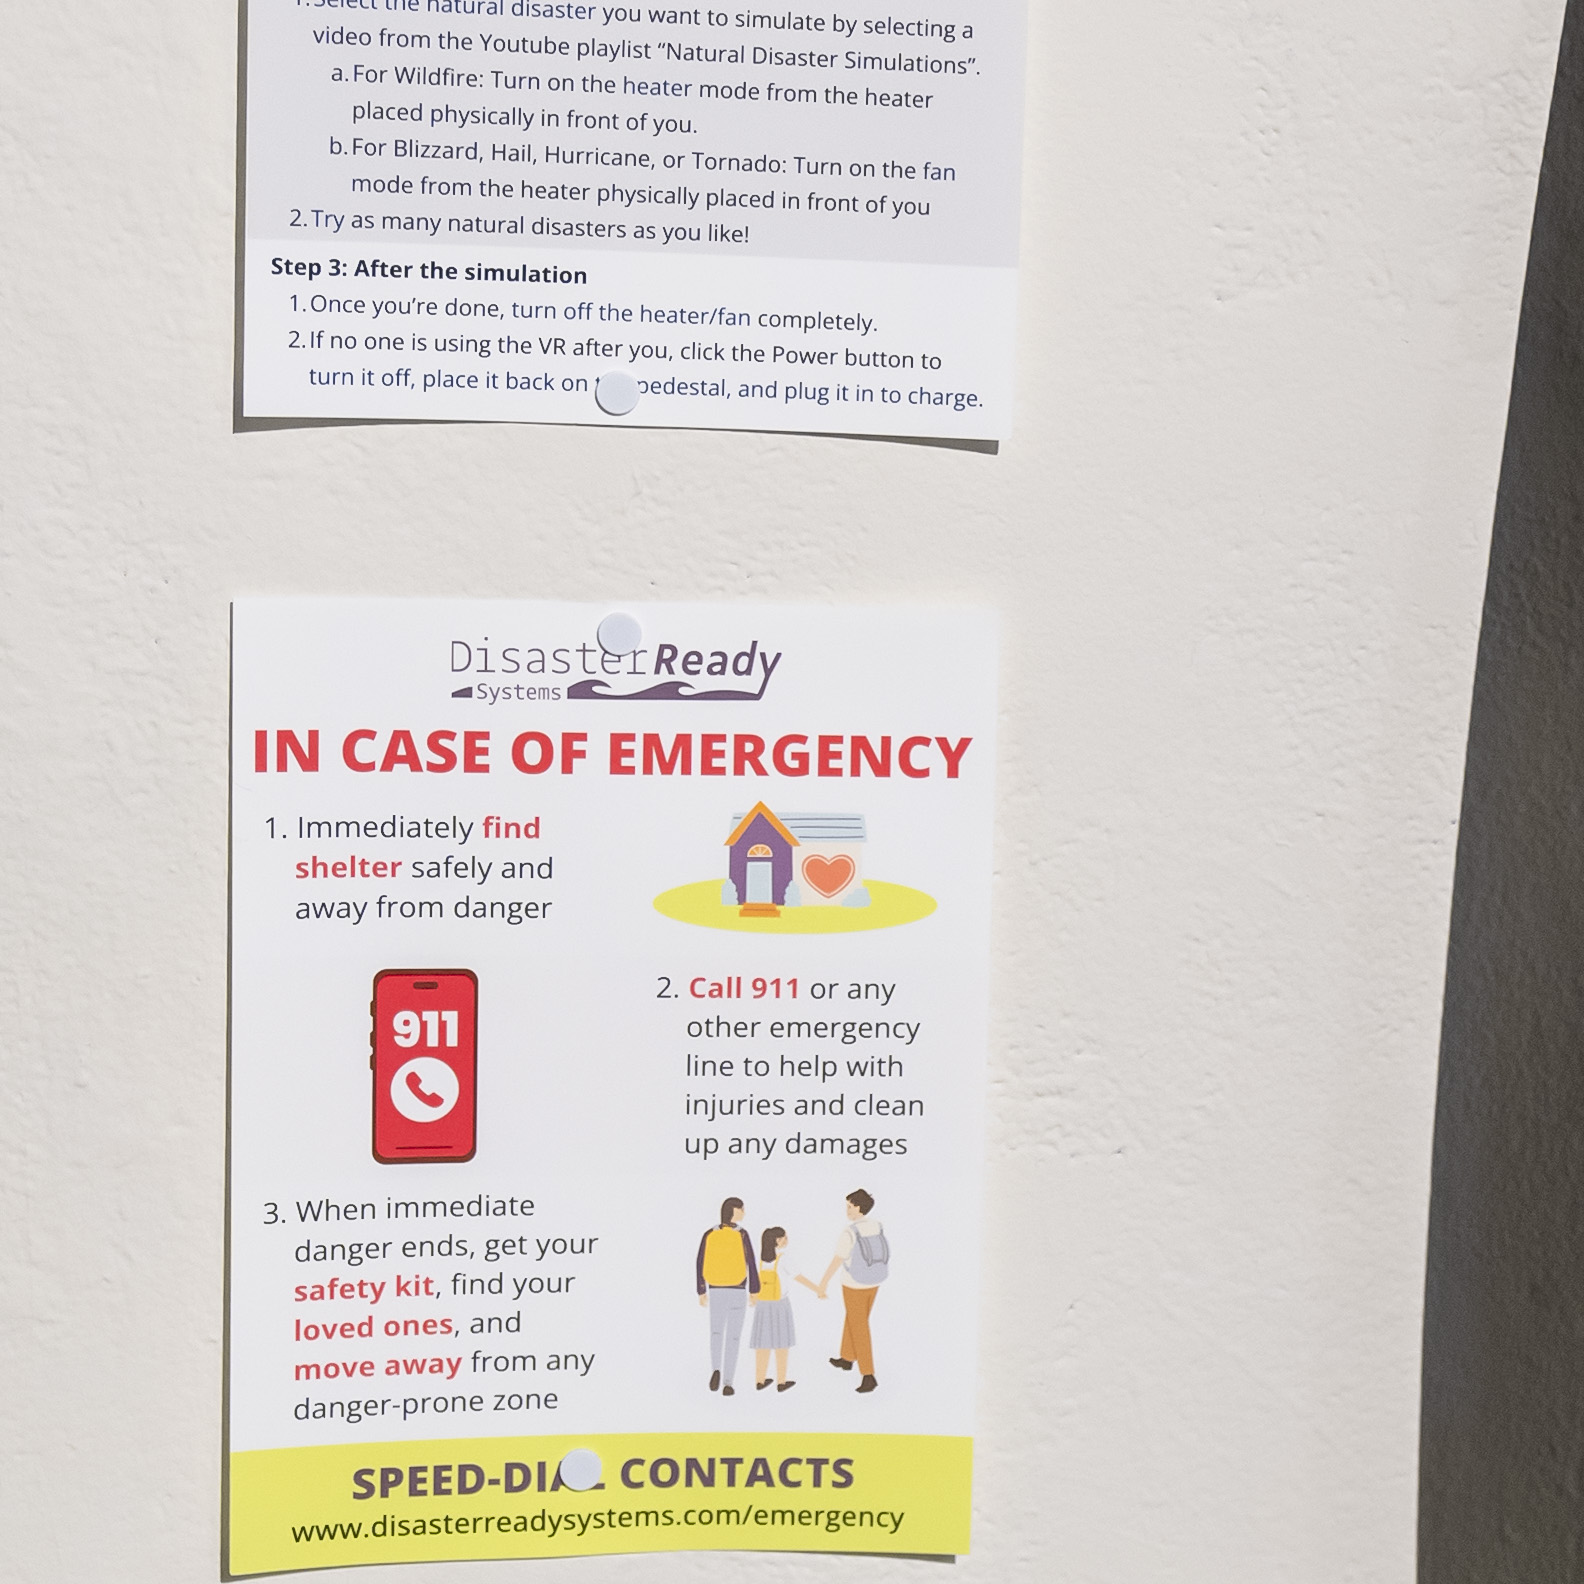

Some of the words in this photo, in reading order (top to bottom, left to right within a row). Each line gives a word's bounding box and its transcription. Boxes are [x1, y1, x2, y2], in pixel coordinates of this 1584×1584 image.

[313, 26, 371, 46] video
[379, 28, 430, 48] from
[438, 31, 472, 51] the
[480, 34, 569, 55] Youtube
[577, 38, 651, 62] playlist
[753, 47, 838, 67] Disaster
[352, 175, 413, 194] mode
[421, 176, 471, 196] from
[479, 179, 513, 198] the
[522, 180, 591, 200] heater
[598, 184, 699, 210] physically
[707, 188, 774, 211] placed
[783, 191, 799, 209] in
[807, 192, 859, 212] front
[866, 195, 888, 213] of
[892, 201, 930, 219] you
[271, 257, 321, 281] Step
[328, 259, 347, 276] 3:
[354, 259, 413, 278] After
[420, 261, 458, 280] the
[465, 263, 586, 284] simulation
[309, 369, 353, 385] turn
[362, 368, 374, 386] it
[382, 368, 415, 390] off,
[424, 369, 478, 392] place
[487, 371, 499, 389] it
[507, 371, 554, 390] back
[562, 378, 587, 391] on
[738, 381, 777, 398] and
[785, 382, 829, 405] plug
[837, 384, 849, 401] it
[856, 384, 873, 402] in
[881, 387, 901, 403] to
[908, 387, 982, 411] charge.
[475, 682, 563, 706] Systems
[255, 729, 319, 773] IN
[342, 729, 490, 773] CASE
[511, 731, 588, 774] OF
[609, 733, 973, 779] EMERGENCY
[299, 815, 474, 845] Immediately
[482, 815, 541, 839] find
[296, 855, 402, 879] shelter
[412, 855, 493, 885] safely
[501, 856, 552, 879] and
[296, 902, 368, 925] away
[376, 895, 443, 918] from
[454, 895, 552, 925] danger
[690, 976, 741, 998] Call
[752, 978, 797, 999] 911
[810, 983, 839, 999] or
[848, 983, 896, 1006] any
[393, 1011, 458, 1047] 911
[687, 1015, 761, 1038] other
[770, 1022, 920, 1045] emergency
[687, 1054, 734, 1076] line
[743, 1058, 769, 1076] to
[780, 1055, 837, 1083] help
[846, 1055, 902, 1077] with
[687, 1094, 784, 1122] injuries
[794, 1093, 844, 1115] and
[854, 1094, 923, 1116] clean
[686, 1138, 719, 1160] up
[728, 1138, 777, 1160] any
[786, 1132, 907, 1161] damages
[296, 1199, 375, 1222] When
[387, 1194, 534, 1219] immediate
[295, 1239, 393, 1266] danger
[402, 1234, 474, 1260] ends,
[484, 1236, 527, 1262] get
[536, 1238, 599, 1261] your
[295, 1277, 386, 1305] safety
[396, 1274, 440, 1299] kit,
[451, 1272, 503, 1295] find
[512, 1277, 576, 1300] your
[295, 1315, 373, 1341] loved
[384, 1318, 459, 1338] ones,
[470, 1311, 520, 1334] and
[295, 1361, 375, 1381] move
[385, 1357, 462, 1380] away
[471, 1350, 536, 1372] from
[547, 1354, 595, 1376] any
[294, 1395, 483, 1423] danger-prone
[493, 1393, 558, 1411] zone
[352, 1460, 606, 1501] SPEED-DI
[620, 1457, 855, 1489] CONTACTS
[291, 1504, 906, 1543] www.disasterreadysystems.com/emergency
